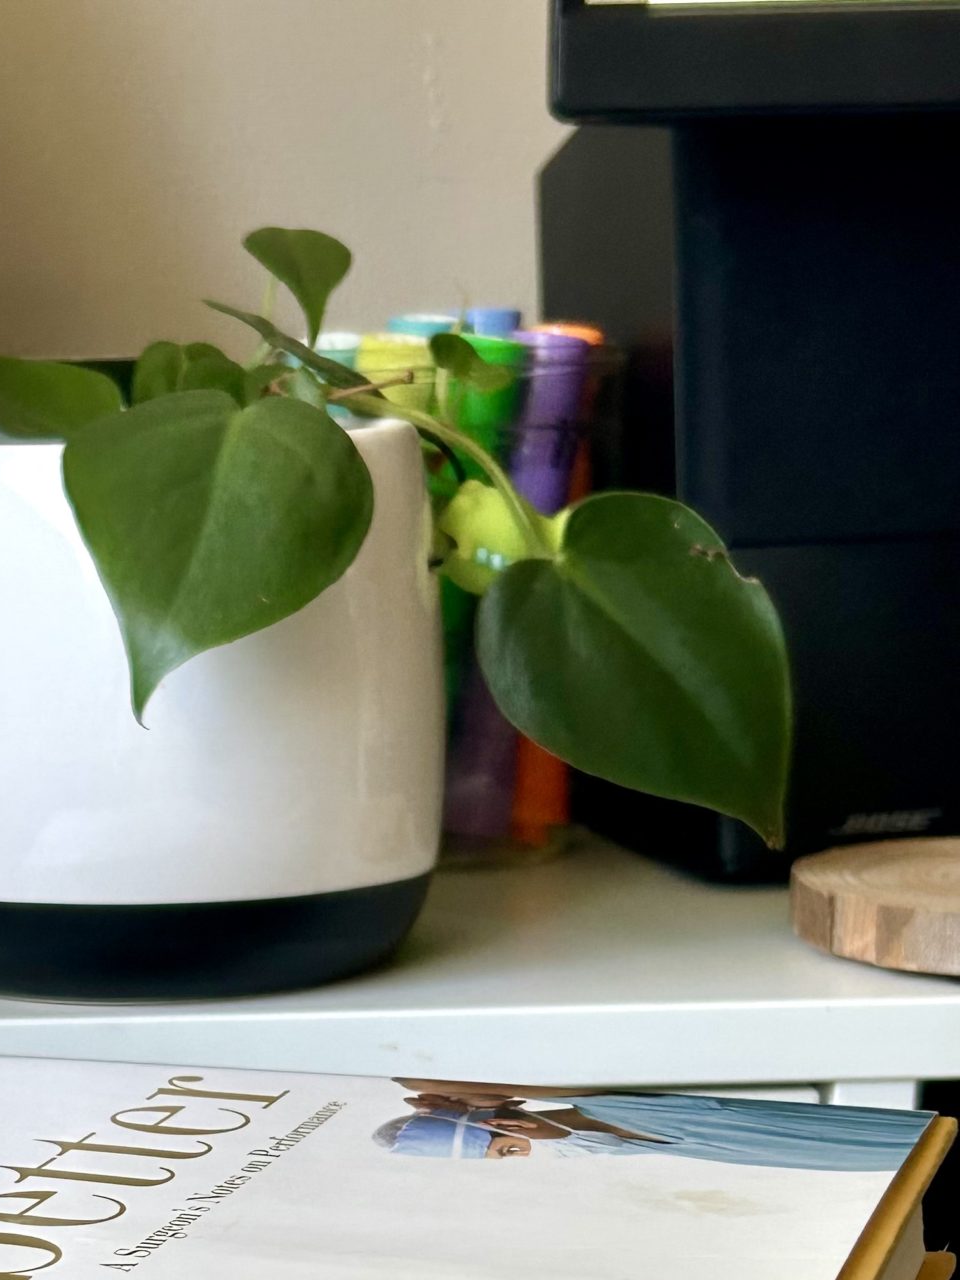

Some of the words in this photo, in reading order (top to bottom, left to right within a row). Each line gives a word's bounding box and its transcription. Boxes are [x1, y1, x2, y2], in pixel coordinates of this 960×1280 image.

[248, 1100, 347, 1157] Performance
[241, 1160, 273, 1173] on
[186, 1174, 252, 1204] Notes
[113, 1206, 211, 1258] Surgeon's
[99, 1262, 139, 1273] A
